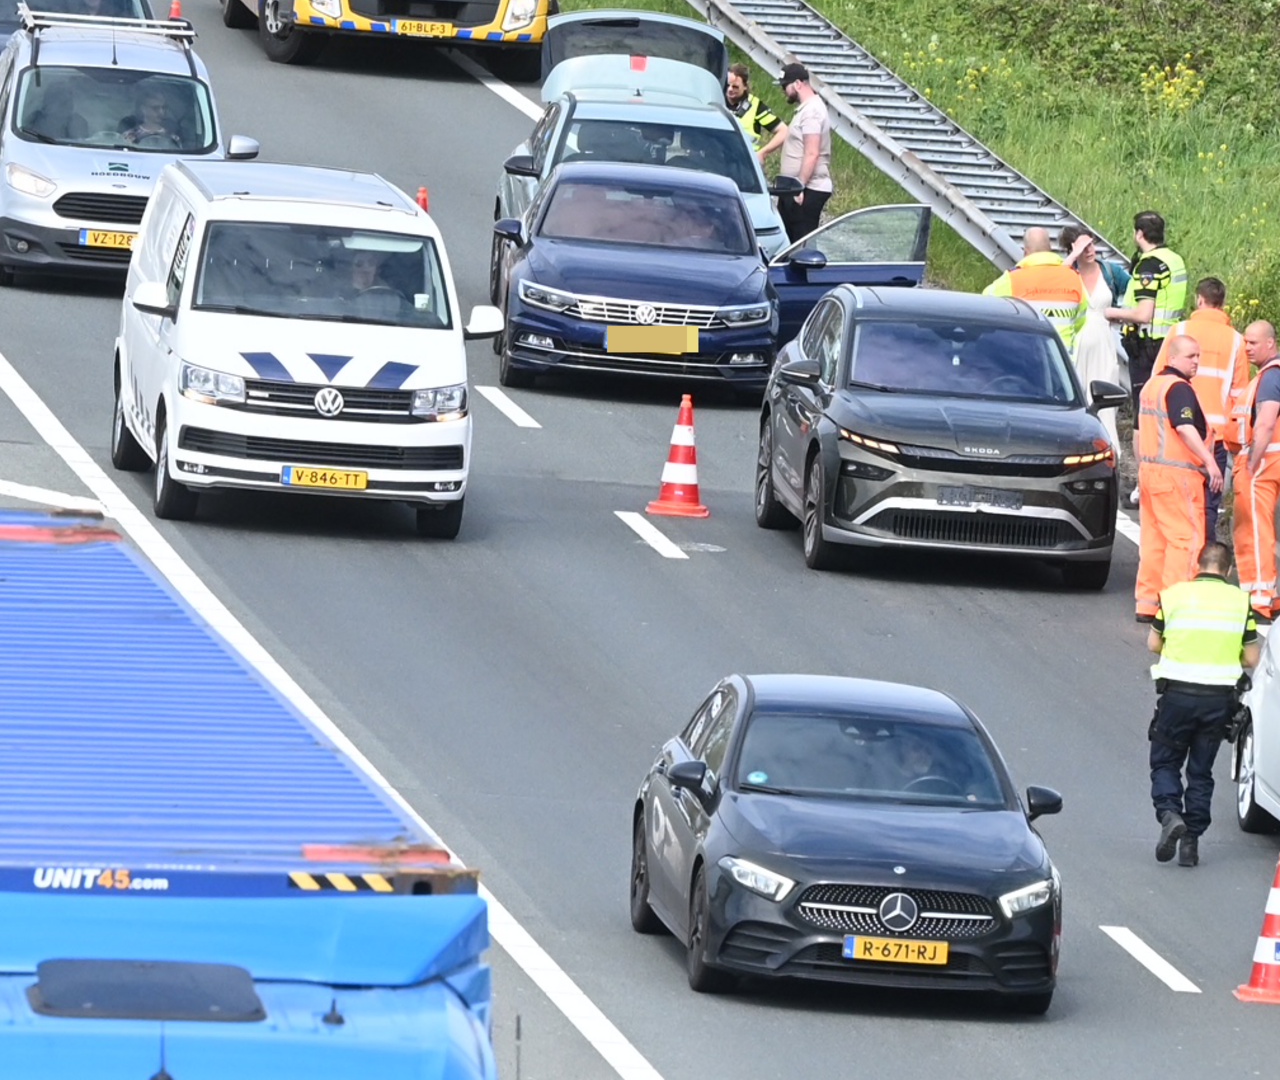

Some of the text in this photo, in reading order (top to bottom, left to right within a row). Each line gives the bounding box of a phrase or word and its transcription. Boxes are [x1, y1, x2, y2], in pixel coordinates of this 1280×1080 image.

[401, 22, 446, 34] 61-BLF-3
[91, 172, 150, 180] HOEDBOUW
[295, 470, 361, 486] V-846-TT
[33, 867, 169, 890] UNIT45.com
[862, 940, 937, 961] R-671-RJ
